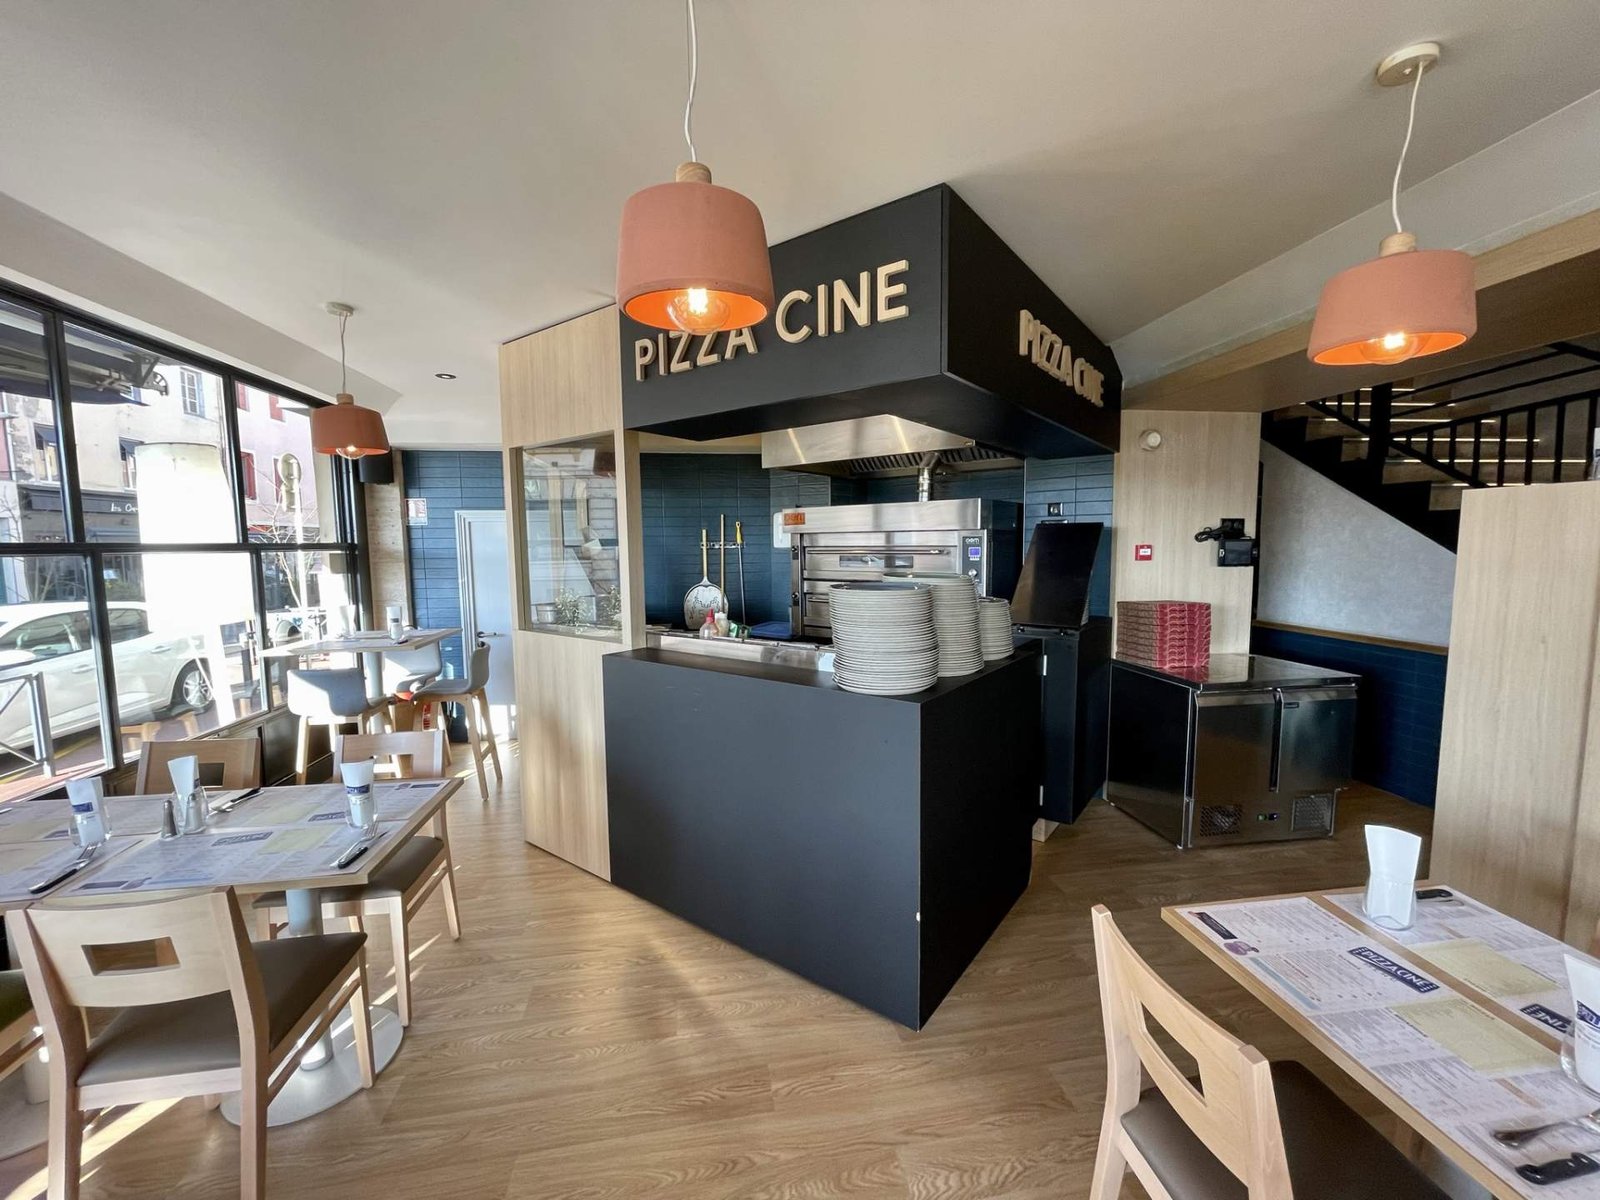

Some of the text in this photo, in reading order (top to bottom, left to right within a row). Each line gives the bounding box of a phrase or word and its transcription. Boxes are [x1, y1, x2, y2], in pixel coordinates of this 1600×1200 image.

[635, 259, 909, 382] PIZZA CINE
[1019, 309, 1073, 387] PIZZA
